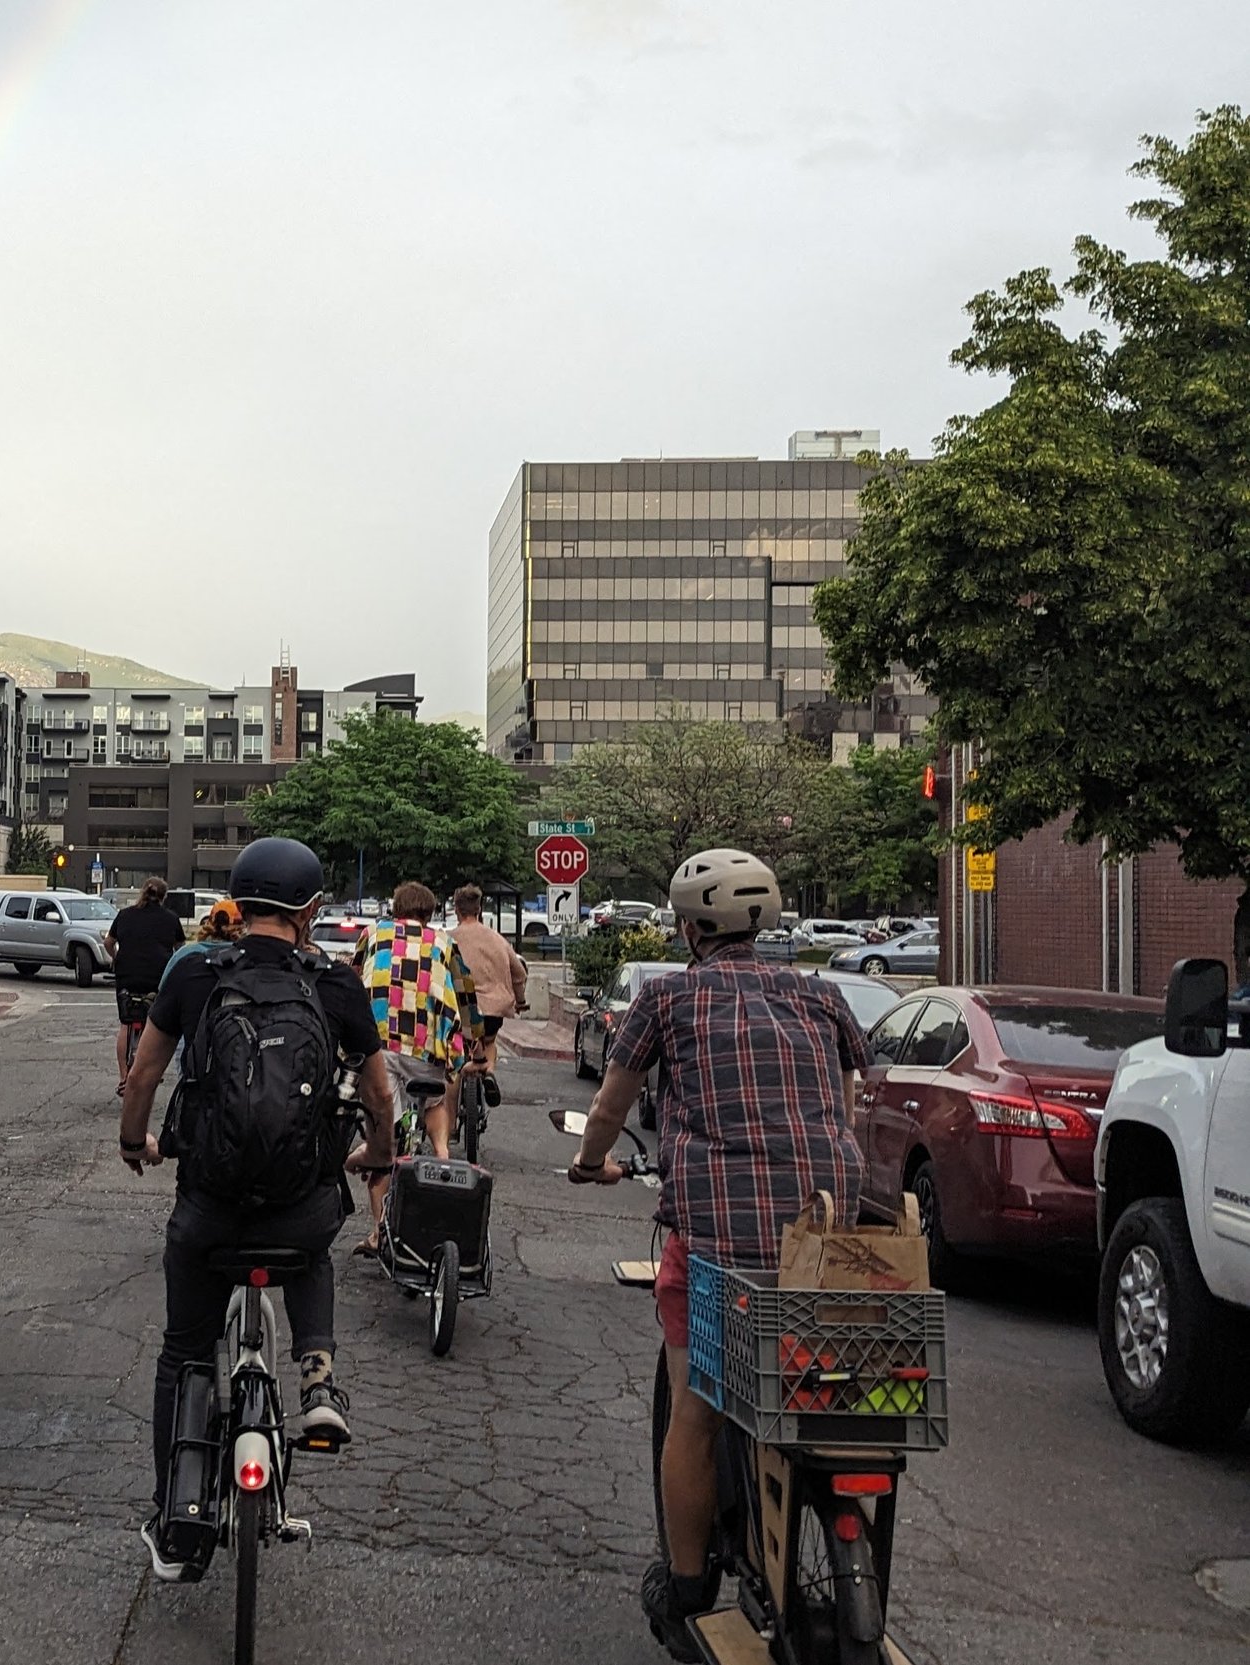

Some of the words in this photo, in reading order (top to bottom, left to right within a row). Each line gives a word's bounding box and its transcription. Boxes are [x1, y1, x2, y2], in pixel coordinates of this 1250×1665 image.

[539, 823, 563, 834] State
[566, 823, 576, 833] St
[539, 850, 585, 870] STOP
[552, 914, 575, 922] ONLY
